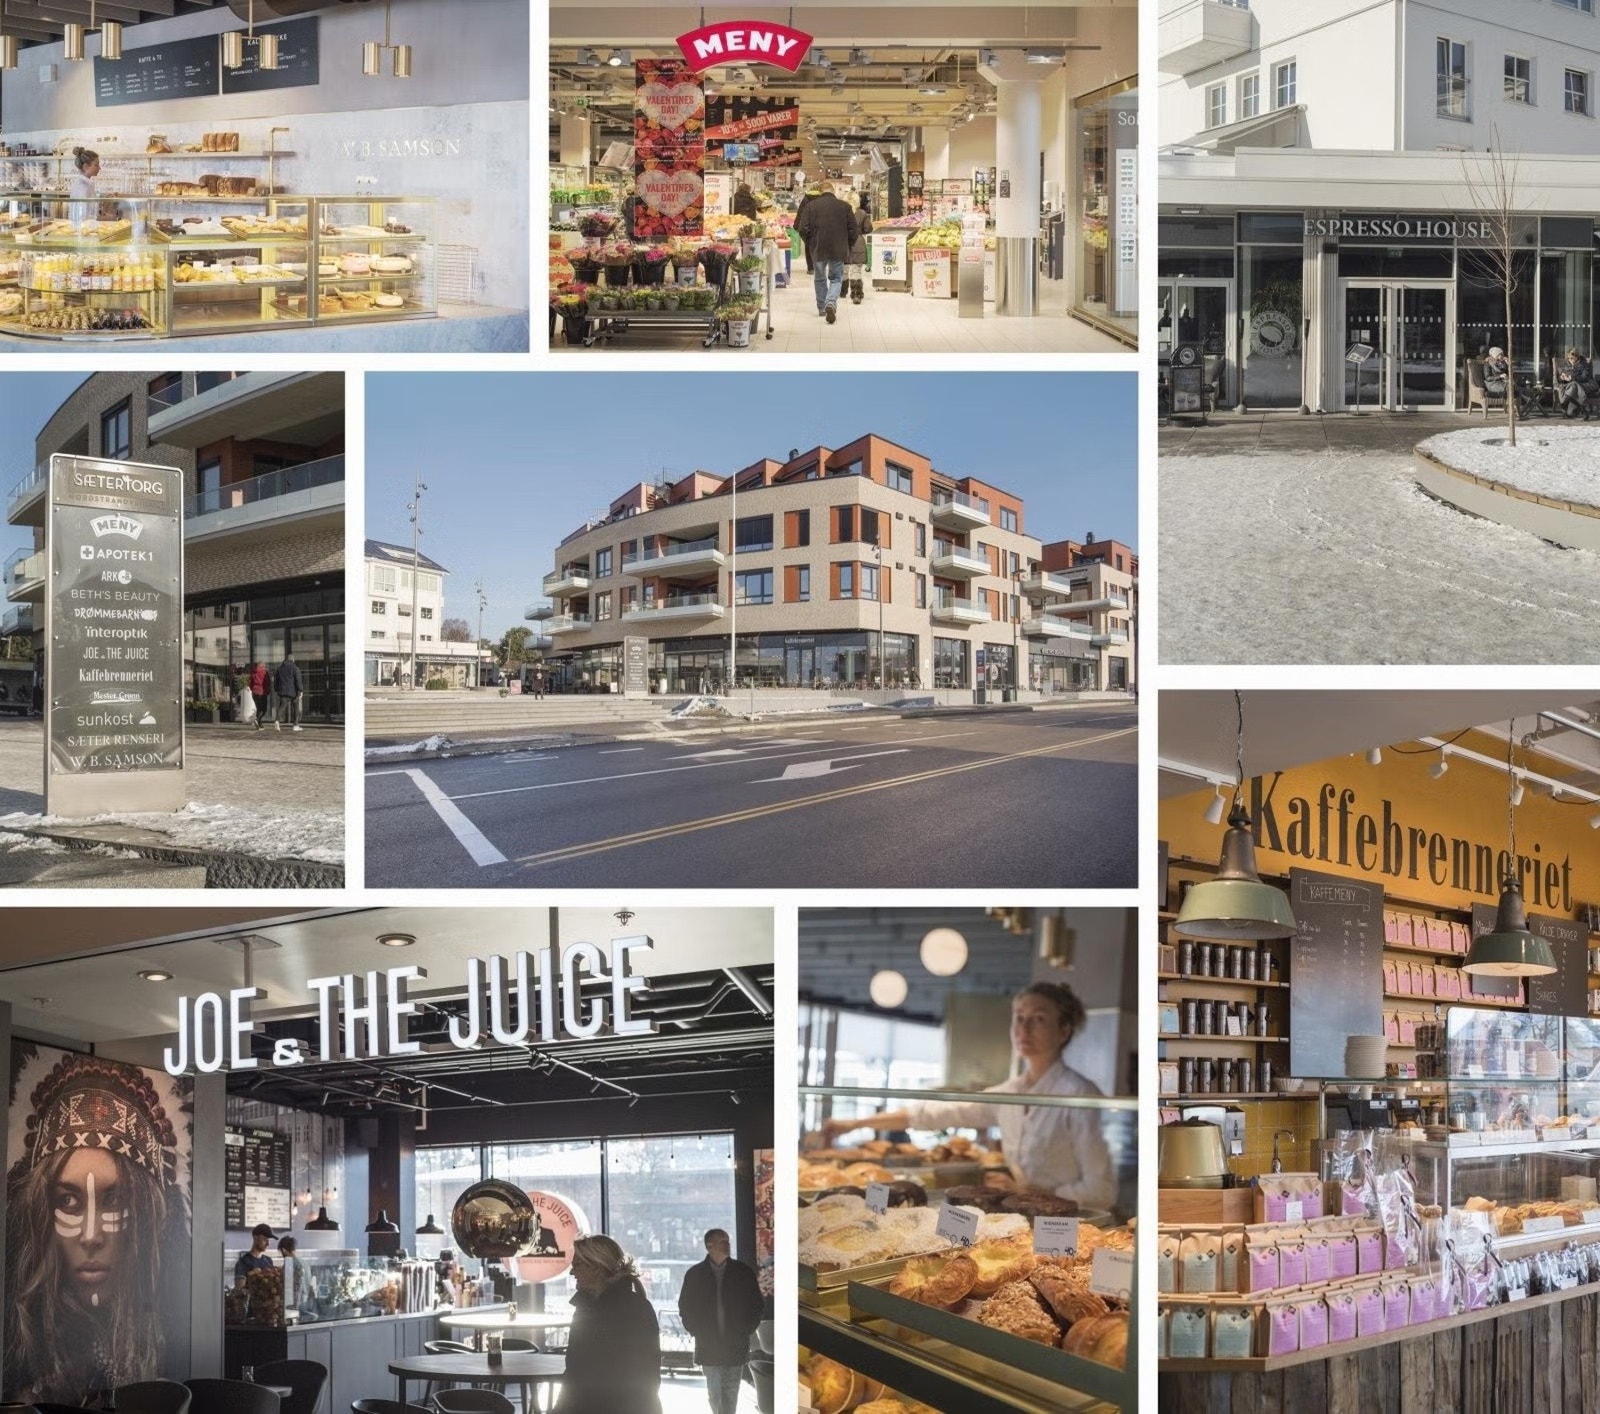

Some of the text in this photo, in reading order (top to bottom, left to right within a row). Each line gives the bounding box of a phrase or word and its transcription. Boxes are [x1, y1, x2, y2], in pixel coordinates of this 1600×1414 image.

[693, 30, 799, 59] MENY
[646, 95, 694, 105] VALENTINES
[661, 105, 679, 115] DAY!
[717, 122, 738, 135] -10%
[745, 116, 767, 129] 5000
[766, 111, 792, 124] VARER
[379, 139, 460, 156] SAMSON
[646, 184, 694, 193] VALENTINES
[661, 193, 679, 202] DAY!
[1304, 219, 1492, 240] ESPRESSO HOUSE
[914, 250, 942, 262] TILBUD
[74, 472, 163, 495] SÆTERTORG
[96, 519, 138, 534] MENY
[96, 549, 146, 562] APOTEK
[101, 570, 119, 582] ARK
[71, 589, 160, 602] BETH'S BEAUTY
[74, 608, 141, 621] DRØMMEBARN
[83, 646, 99, 660] JOE
[106, 647, 122, 660] THE
[124, 647, 150, 660] JUICE
[79, 668, 153, 682] Kaffebrenneriet
[76, 712, 134, 727] sunkost
[67, 733, 165, 747] SÆTER RENSERI
[105, 752, 164, 766] SAMSON
[1250, 770, 1573, 913] Kaffebrenneriet
[164, 935, 661, 1077] JOE & THE JUICE
[532, 1196, 573, 1229] HE JUICE
